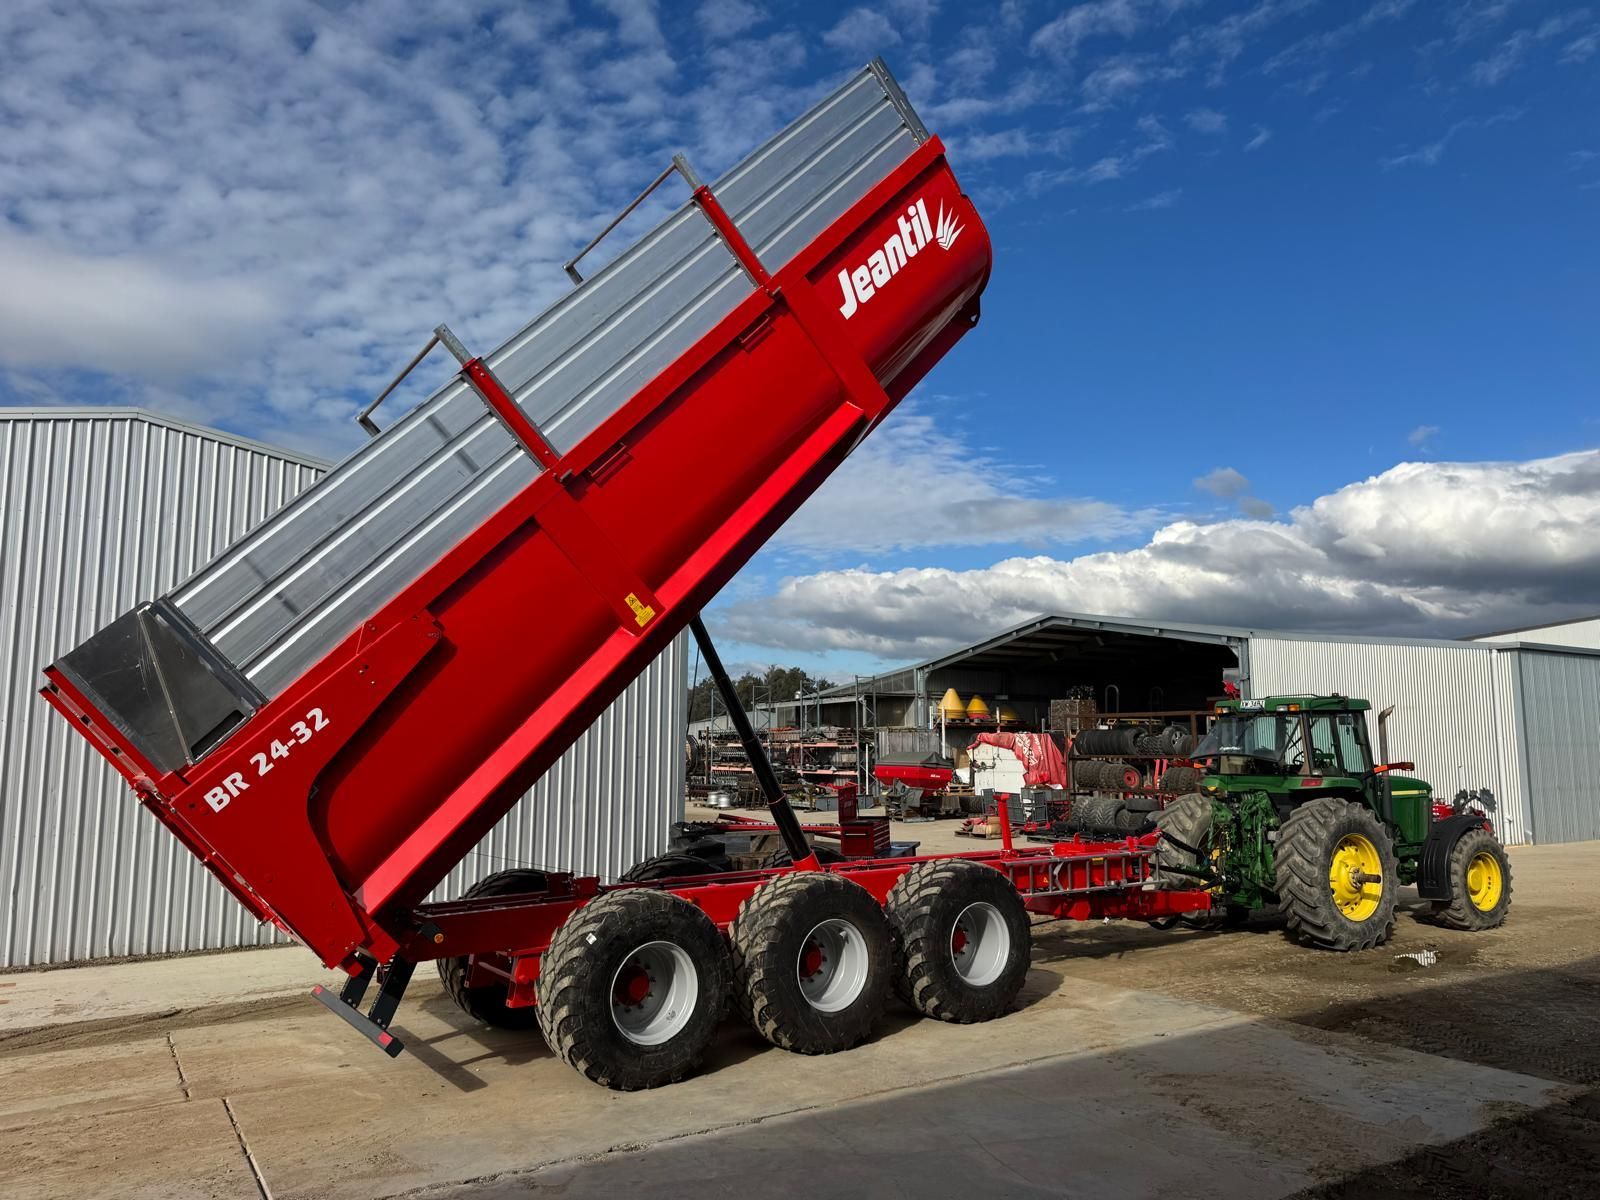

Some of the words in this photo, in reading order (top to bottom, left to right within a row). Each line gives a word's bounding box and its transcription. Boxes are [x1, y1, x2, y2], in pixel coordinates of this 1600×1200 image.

[837, 197, 934, 320] Jeantil
[203, 771, 250, 813] BR
[249, 707, 330, 777] 24-32
